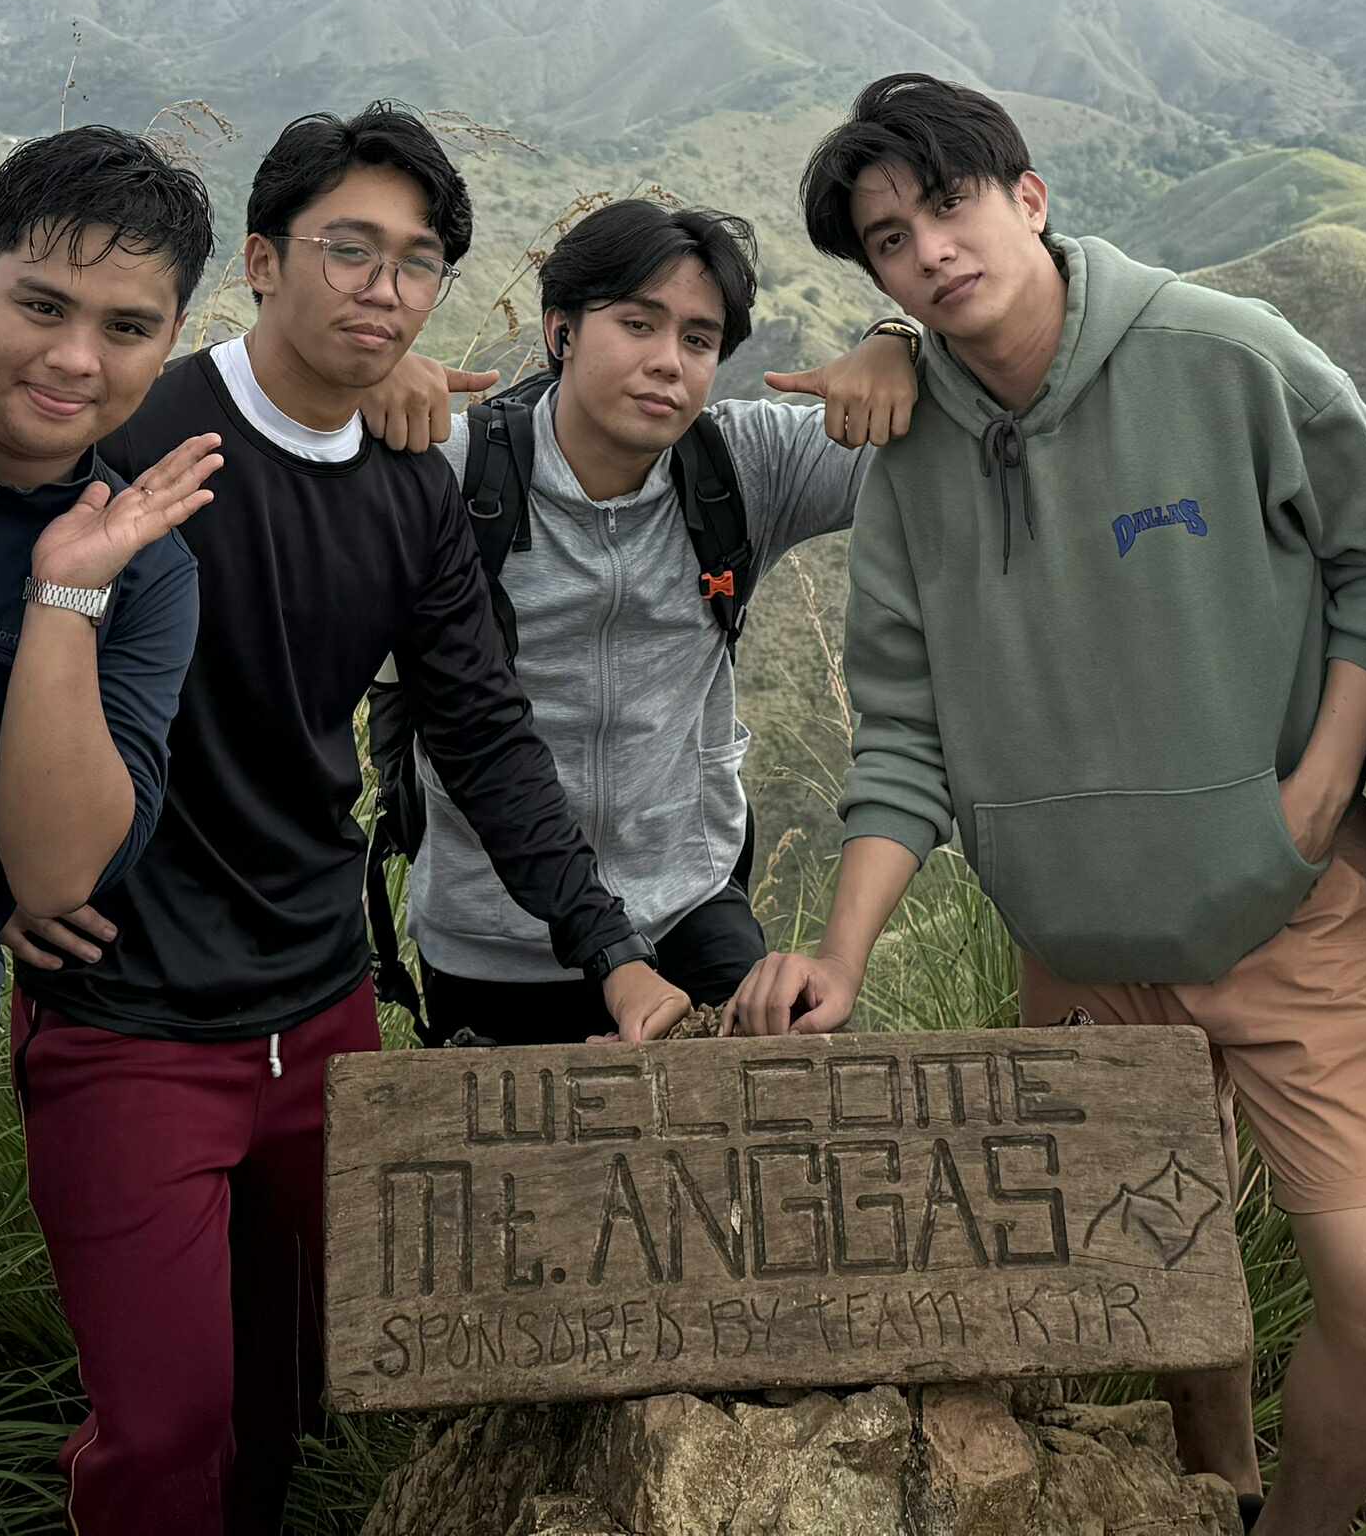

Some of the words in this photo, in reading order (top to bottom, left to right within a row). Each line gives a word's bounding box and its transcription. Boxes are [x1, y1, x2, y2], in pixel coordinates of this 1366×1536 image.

[1112, 498, 1208, 558] DALLAS
[462, 1049, 1086, 1147] WELCOME
[587, 1134, 1070, 1286] ANGGAS
[373, 1299, 685, 1379] SPONSORED
[708, 1298, 780, 1358] BY
